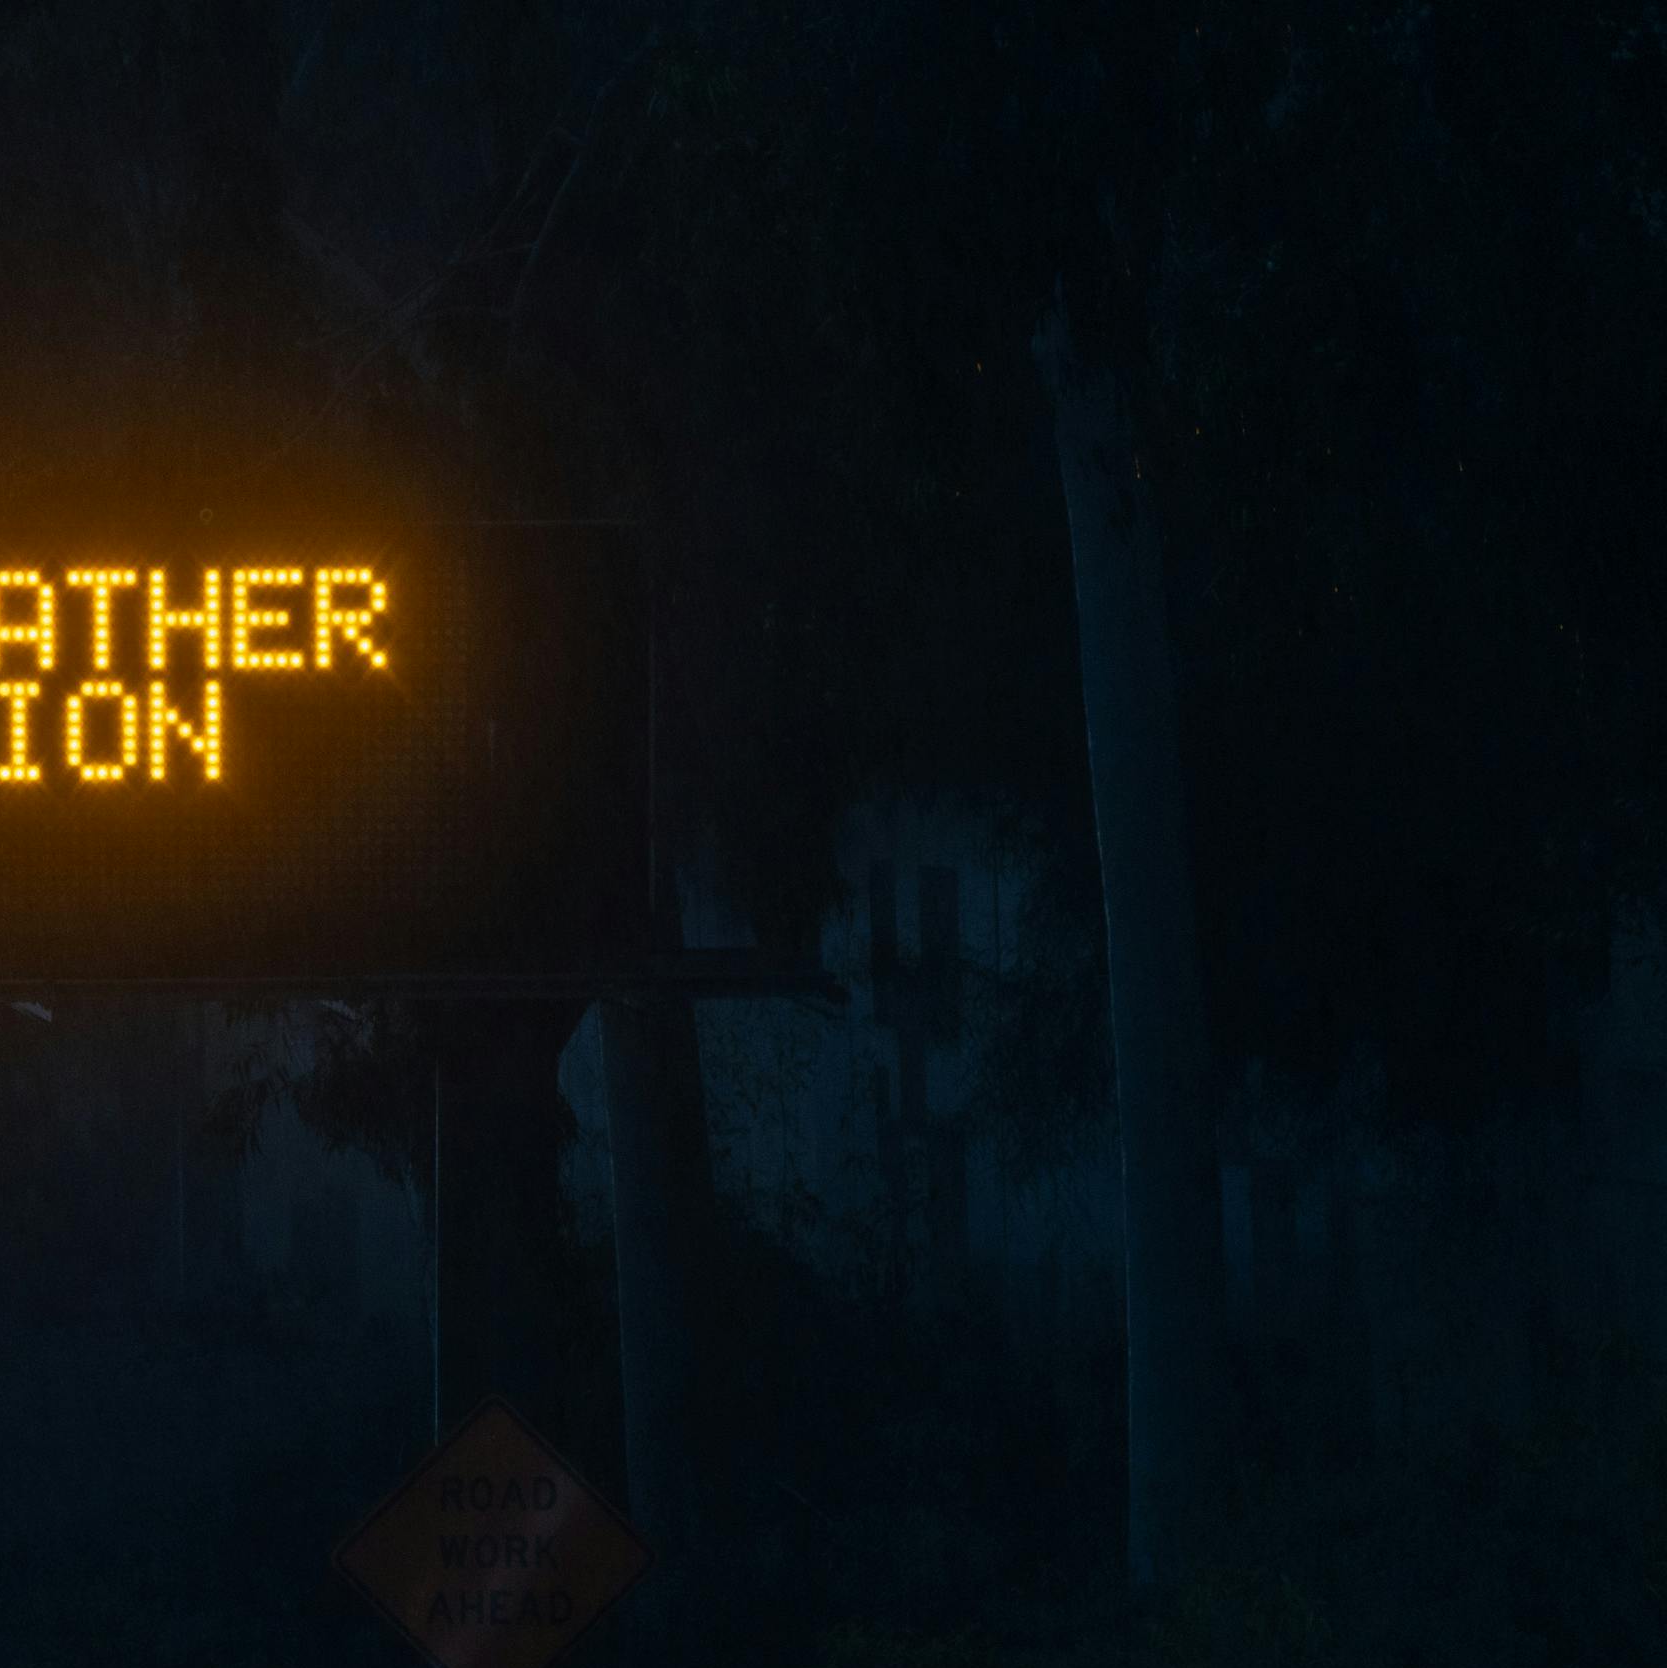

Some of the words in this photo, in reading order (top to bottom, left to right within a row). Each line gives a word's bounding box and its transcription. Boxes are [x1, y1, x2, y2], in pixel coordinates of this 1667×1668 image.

[438, 1474, 558, 1513] ROAD
[438, 1533, 560, 1571] WORK
[425, 1590, 575, 1626] AHEAD
